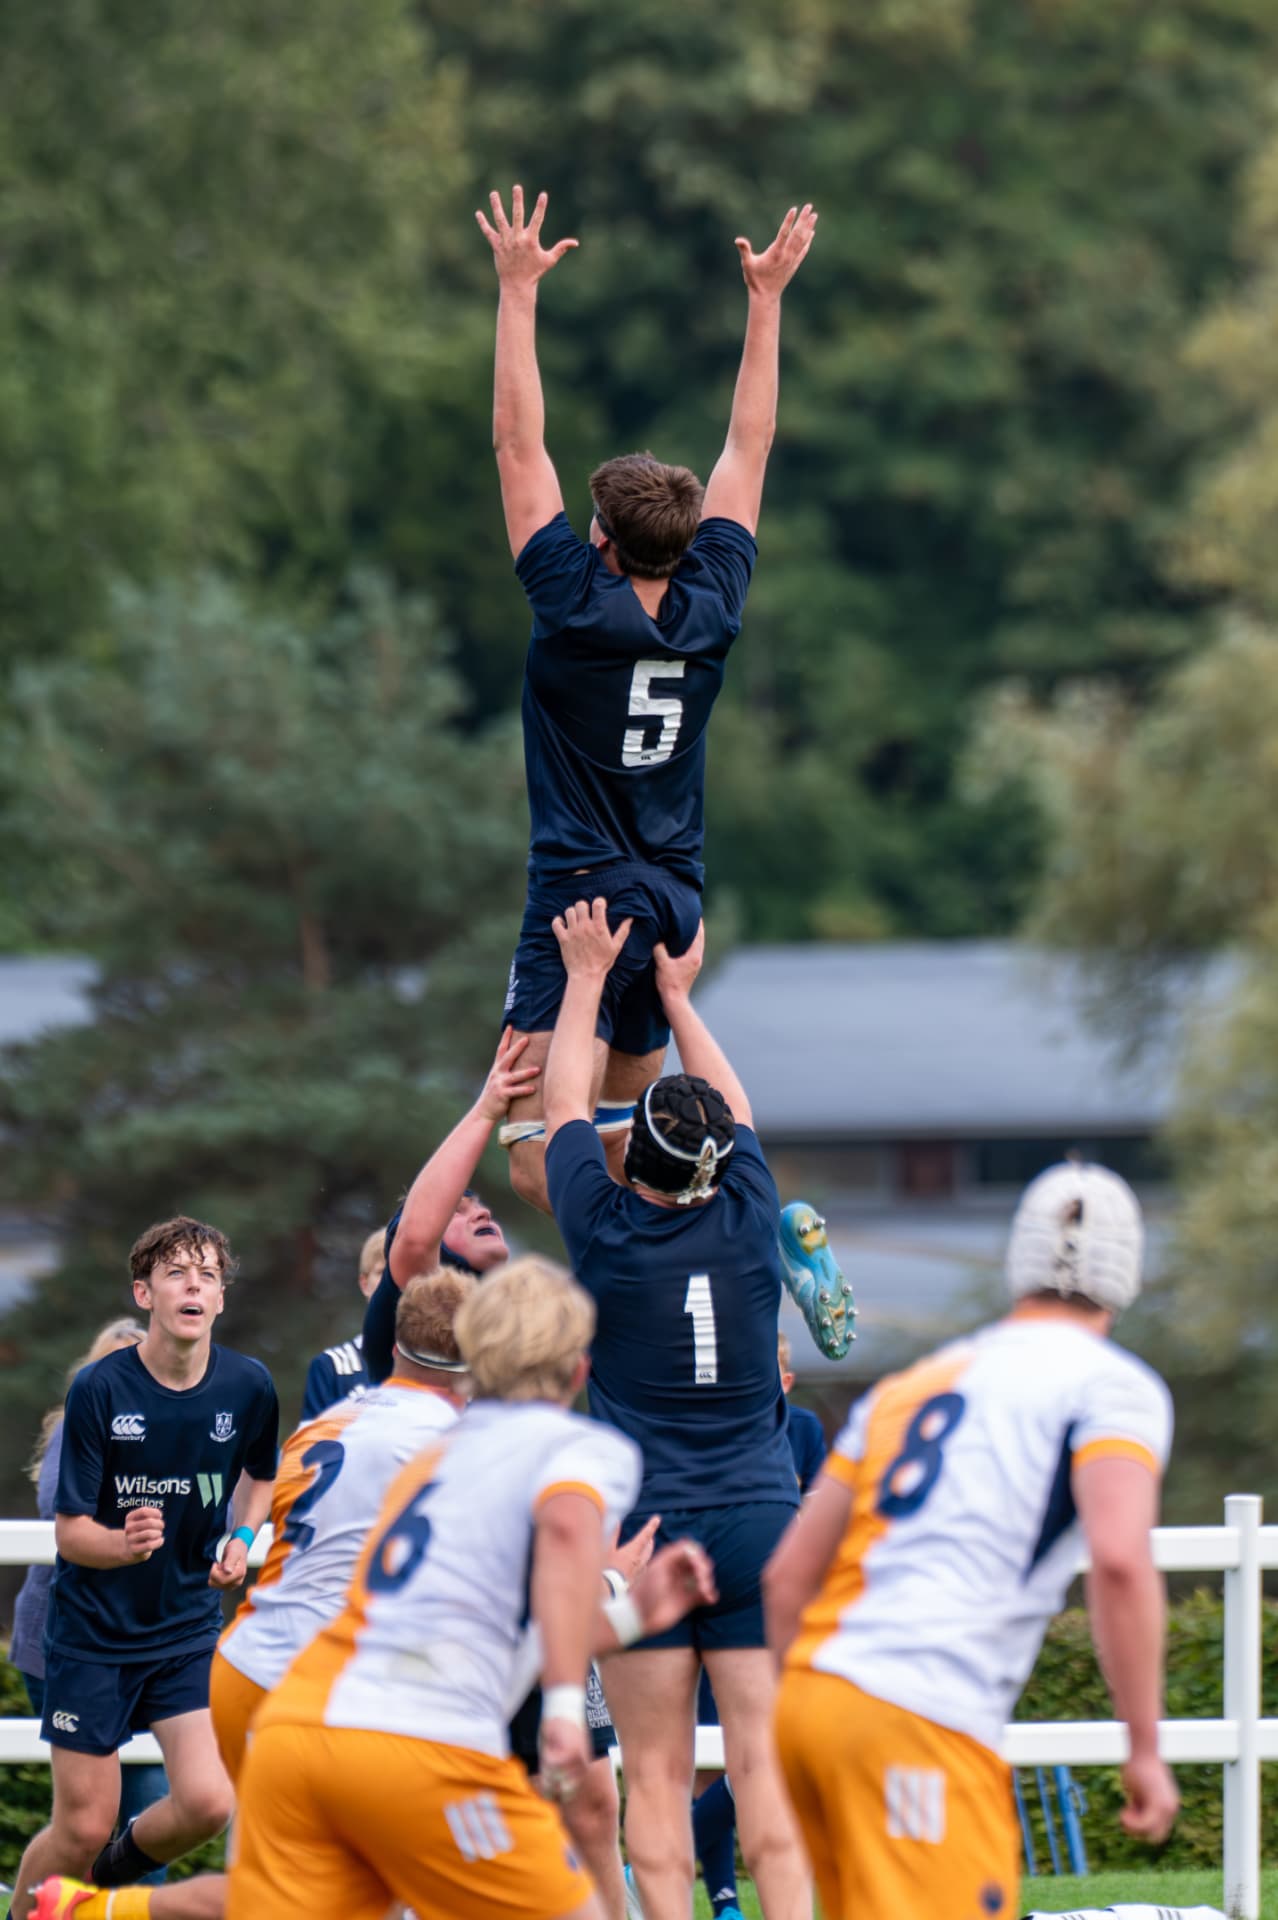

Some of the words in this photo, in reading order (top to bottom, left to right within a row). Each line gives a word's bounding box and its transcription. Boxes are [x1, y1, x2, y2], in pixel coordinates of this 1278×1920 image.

[622, 660, 686, 767] 5
[684, 1275, 717, 1384] 1
[114, 1475, 191, 1495] Wilsons
[117, 1497, 165, 1509] Solicitors
[280, 1440, 346, 1551] 2
[877, 1393, 965, 1518] 8
[365, 1480, 441, 1594] 6
